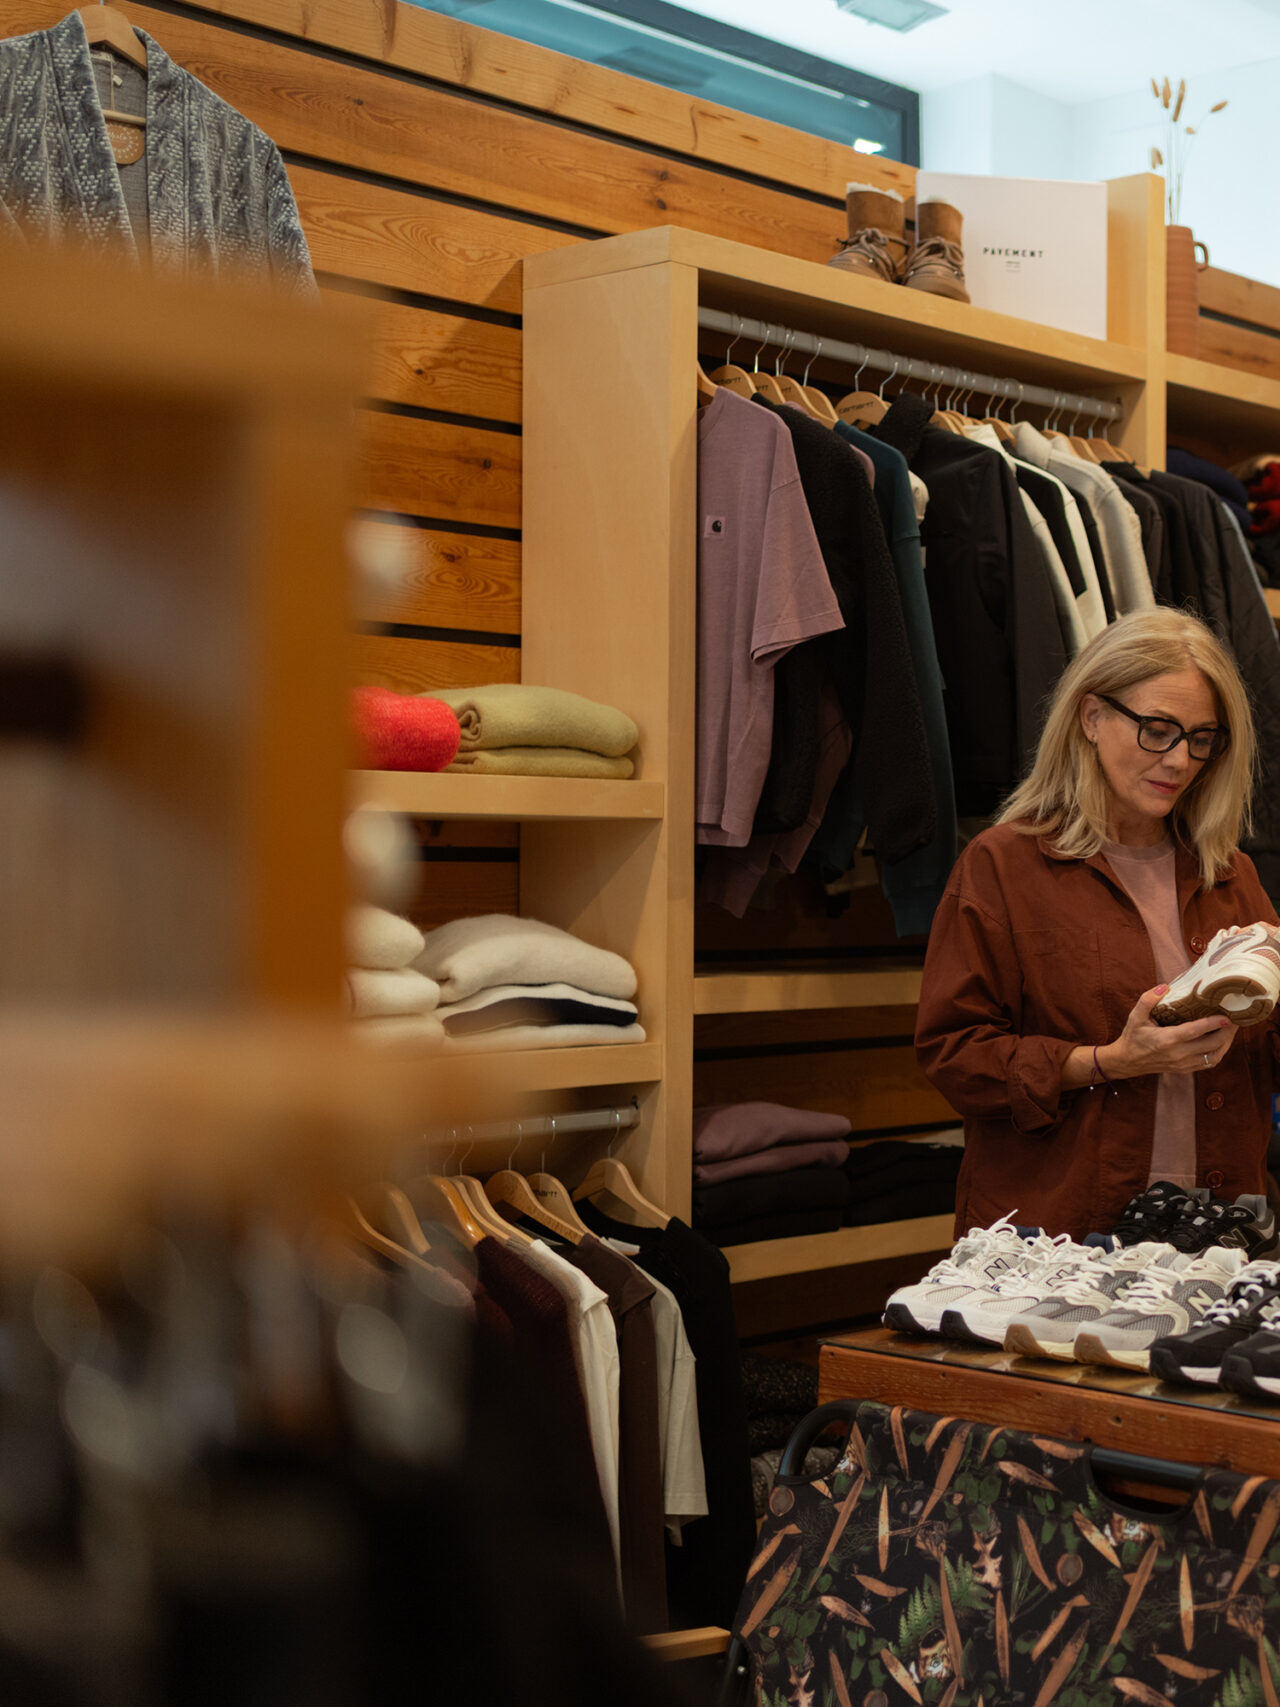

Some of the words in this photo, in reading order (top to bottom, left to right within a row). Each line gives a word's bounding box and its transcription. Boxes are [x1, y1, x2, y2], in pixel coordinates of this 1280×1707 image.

[983, 247, 1043, 258] PAVEMENT
[1218, 1228, 1250, 1250] N
[984, 1257, 1011, 1280] N
